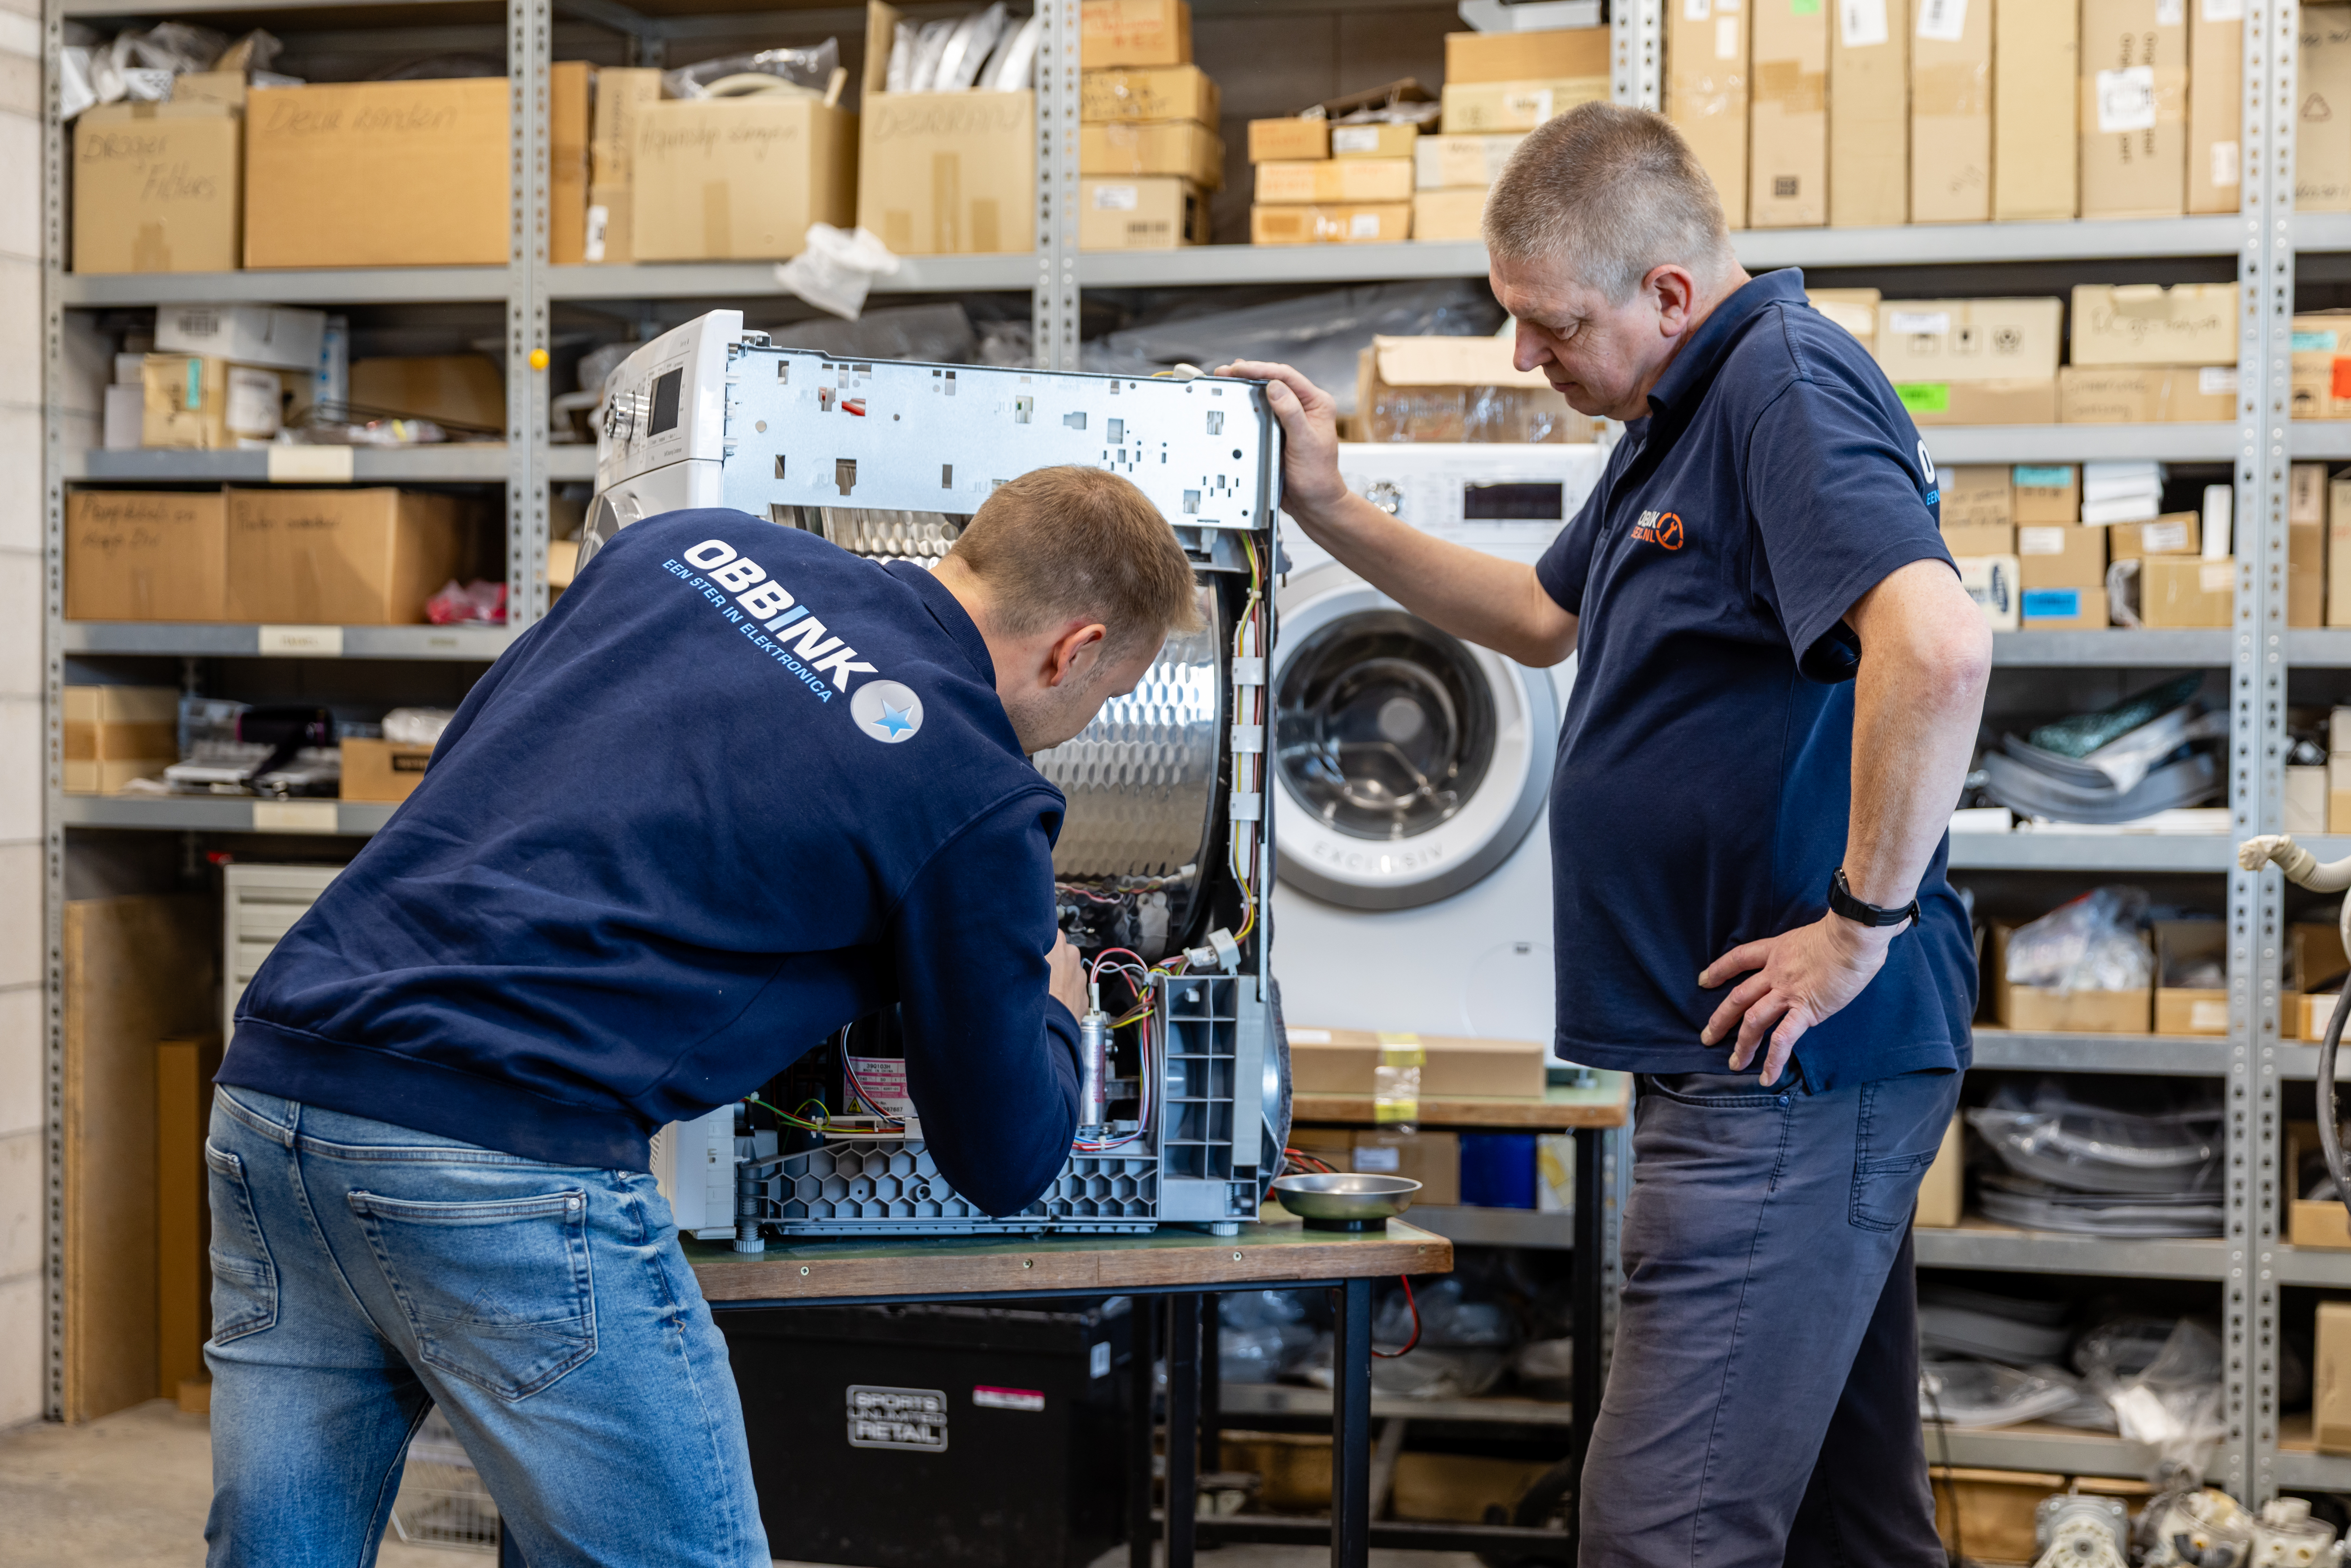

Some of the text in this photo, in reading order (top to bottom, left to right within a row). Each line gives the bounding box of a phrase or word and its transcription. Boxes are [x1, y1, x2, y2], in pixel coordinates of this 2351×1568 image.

[1917, 439, 1936, 484] O
[662, 559, 832, 703] EEN STER IN ELEKTRONICA
[684, 539, 878, 693] OBBINK
[855, 1392, 939, 1412] SPORTS
[856, 1420, 940, 1445] RETAIL
